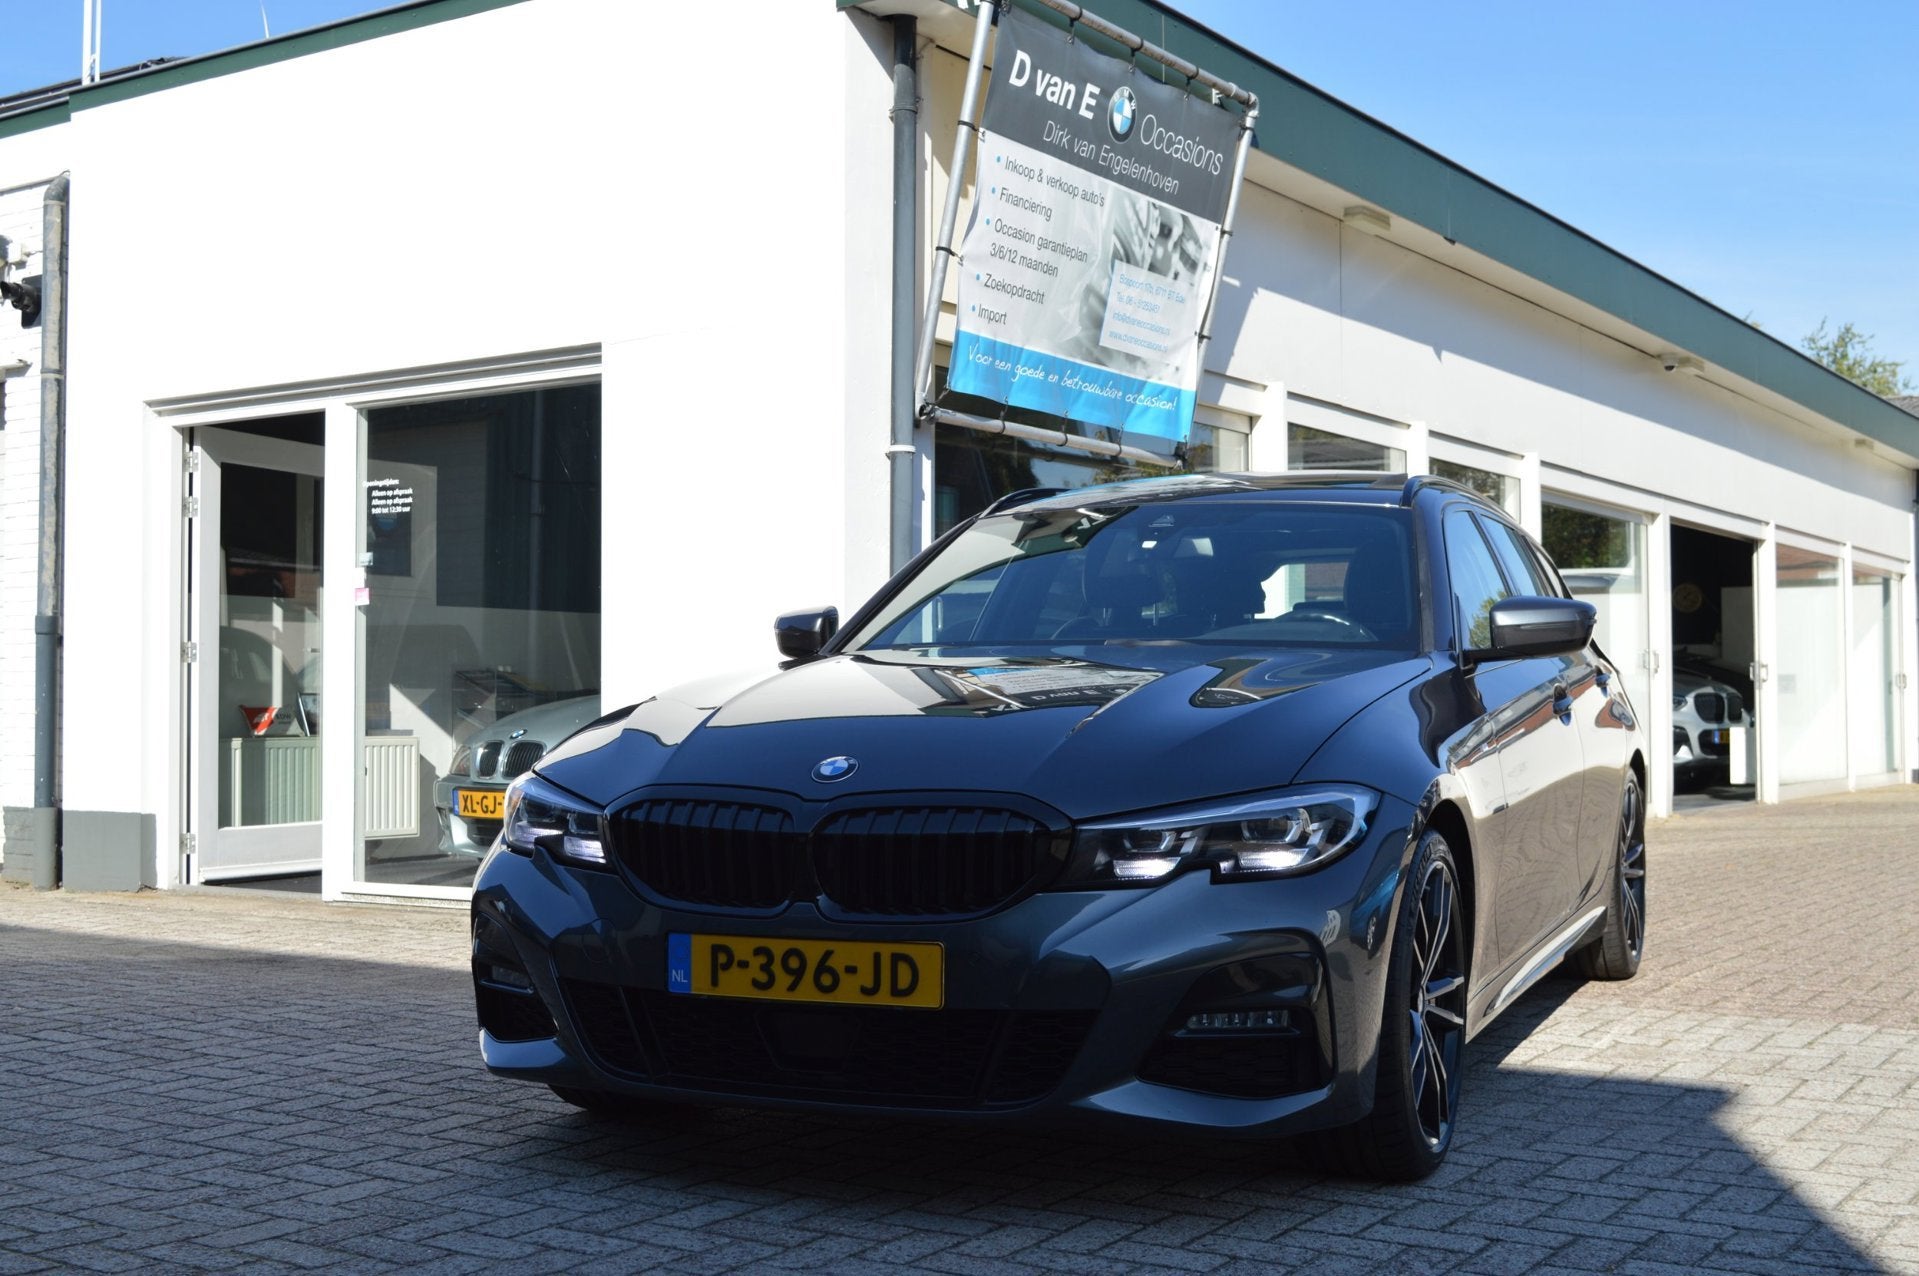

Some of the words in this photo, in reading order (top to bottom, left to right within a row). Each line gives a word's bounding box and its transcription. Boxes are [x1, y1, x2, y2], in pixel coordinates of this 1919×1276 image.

[1008, 49, 1032, 88] D
[1036, 67, 1077, 110] van
[1078, 82, 1101, 120] E
[1140, 113, 1224, 176] Occasions
[1043, 119, 1068, 150] Dirk
[1073, 135, 1096, 159] van
[1098, 144, 1180, 196] Engelenhoven
[1004, 155, 1035, 181] Inkoop
[1036, 167, 1044, 183] &
[1046, 174, 1080, 199] verkoop
[1080, 187, 1106, 208] auto's
[999, 186, 1053, 222] Financiering
[989, 241, 1018, 264] 3/6/12
[1018, 254, 1059, 278] maanden
[994, 217, 1036, 245] Occasion
[1036, 235, 1089, 263] garantieplan
[983, 272, 1046, 305] Zoekopdracht
[977, 303, 1008, 325] Import
[968, 343, 993, 367] Voor
[994, 357, 1012, 373] een
[1012, 361, 1046, 383] goede
[1047, 371, 1059, 384] en
[1060, 369, 1123, 401] betrouwbare
[1125, 388, 1178, 411] occasion!
[462, 794, 505, 815] XL-GJ-
[671, 968, 688, 983] NL
[710, 942, 920, 999] P-396-JD
